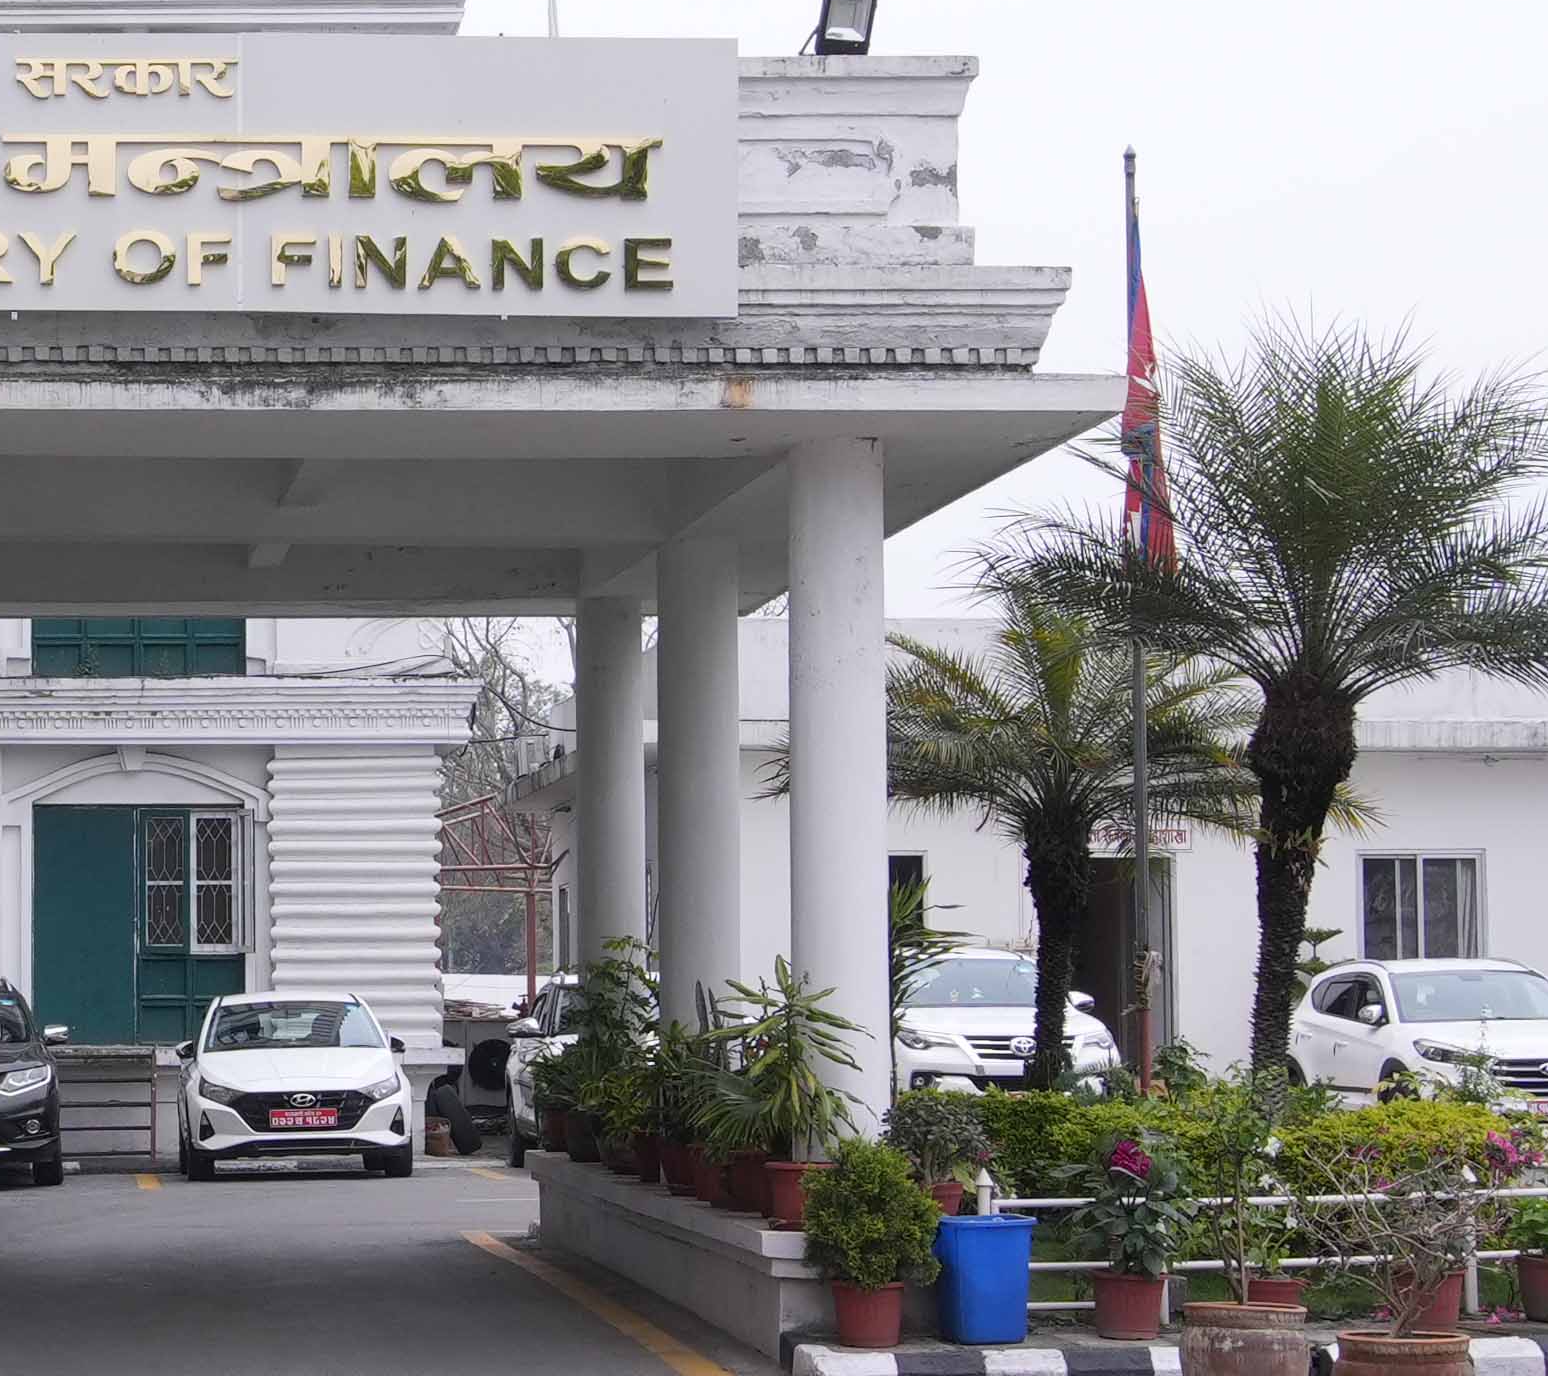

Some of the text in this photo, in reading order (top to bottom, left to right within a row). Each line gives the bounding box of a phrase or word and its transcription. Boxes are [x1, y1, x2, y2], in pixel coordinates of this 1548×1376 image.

[15, 57, 240, 100] सरकार
[0, 132, 664, 203] मन्त्रालय
[112, 230, 233, 287] OF
[271, 232, 675, 292] FINANCE
